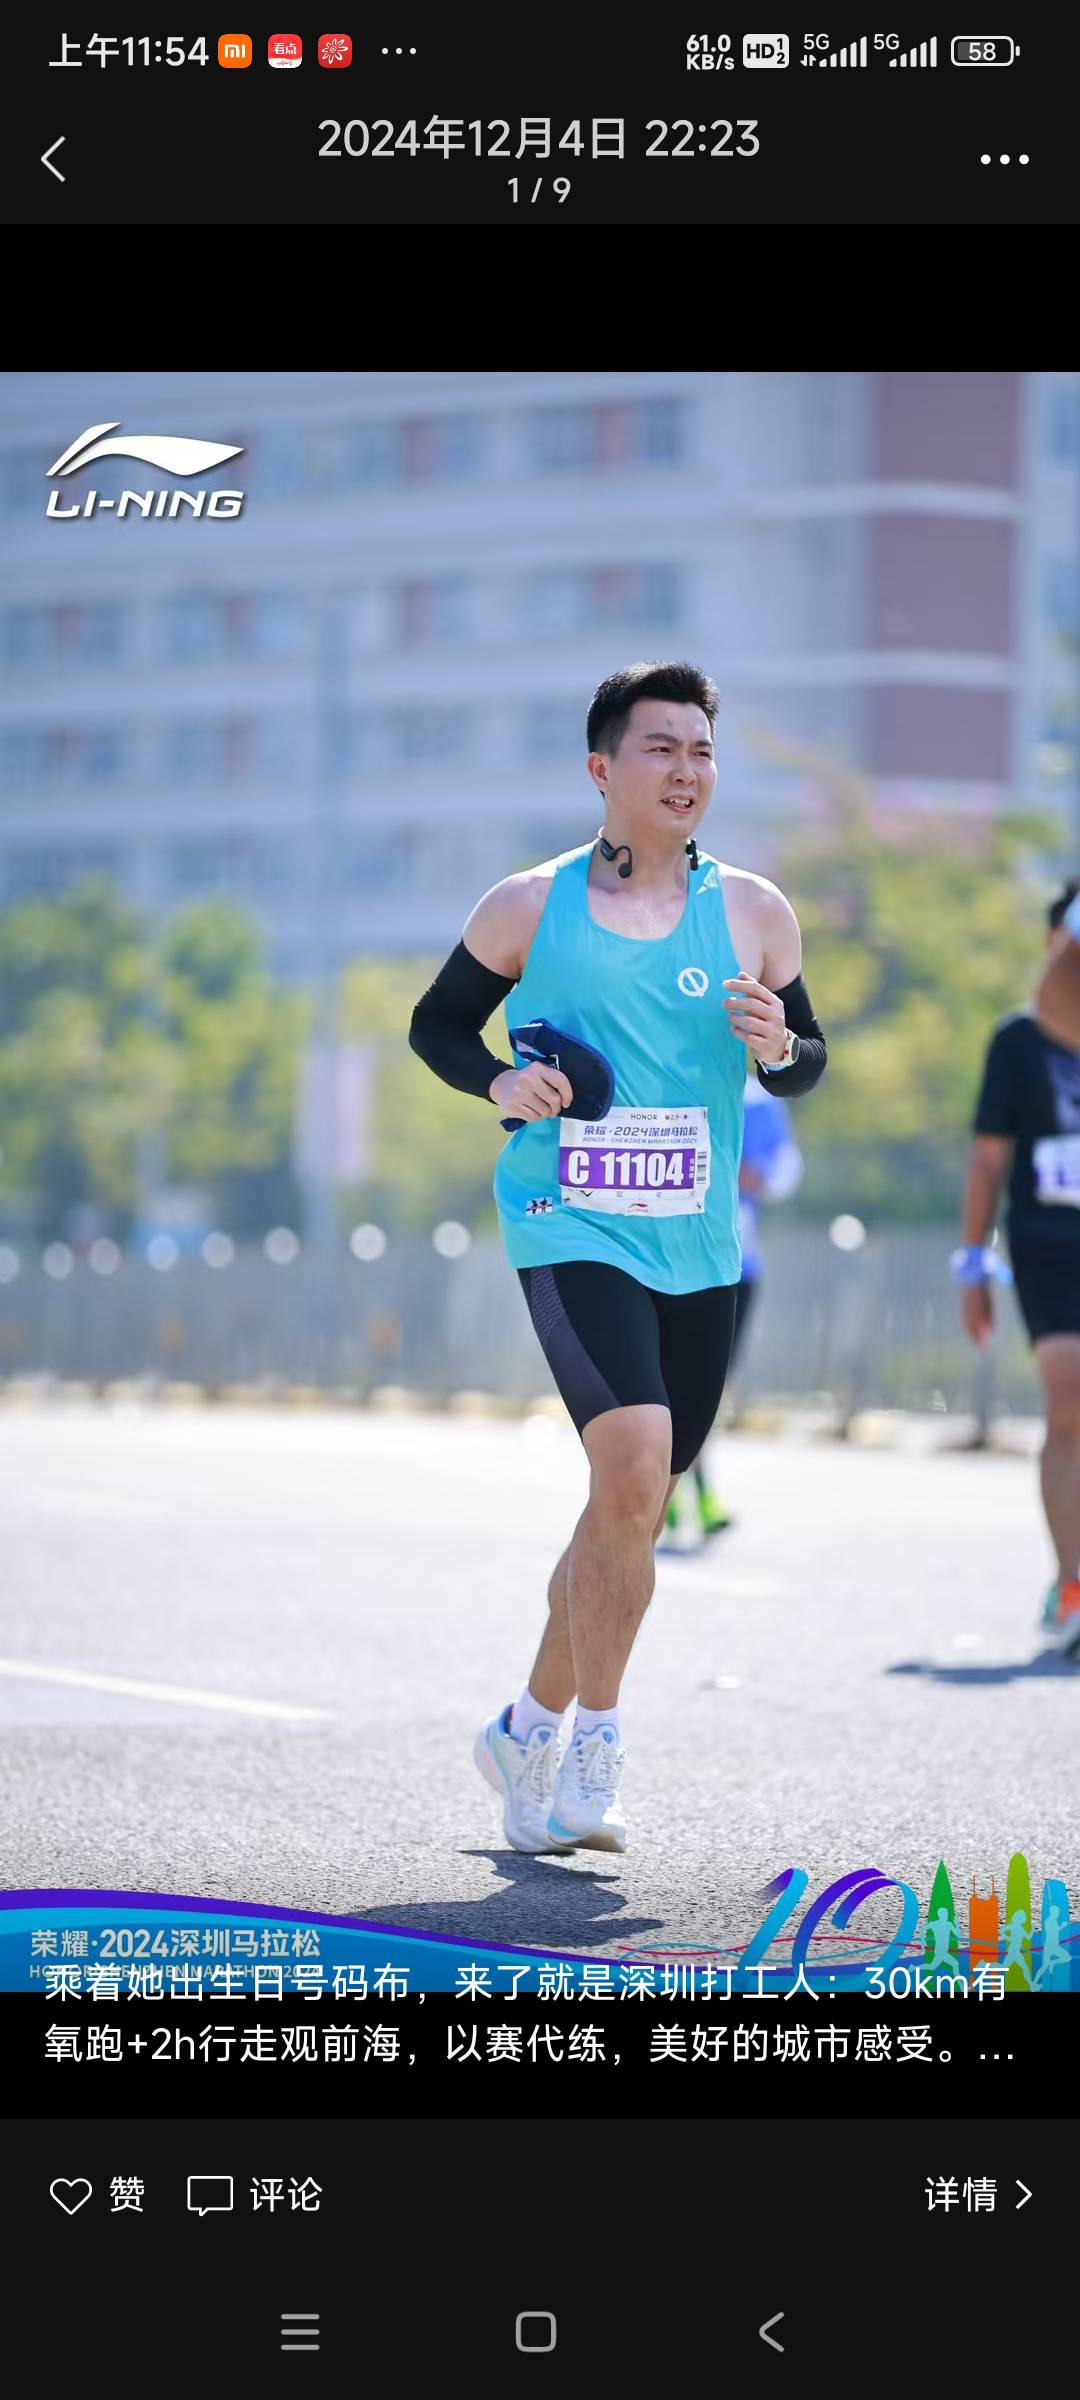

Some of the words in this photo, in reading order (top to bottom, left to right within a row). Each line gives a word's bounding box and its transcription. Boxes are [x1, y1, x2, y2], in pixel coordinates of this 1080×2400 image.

[49, 33, 210, 69] 上午11:54
[686, 35, 731, 52] 61.0
[746, 43, 775, 58] HD
[803, 34, 830, 50] 5G
[873, 34, 900, 50] 5G
[968, 43, 997, 61] 58
[686, 54, 735, 70] KB/s
[319, 114, 625, 160] 2024年12月4日
[646, 117, 760, 157] 22:23
[631, 1113, 658, 1121] HONOR
[568, 1150, 590, 1185] C
[600, 1151, 684, 1187] 11104
[110, 2176, 145, 2212] 赞
[249, 2176, 323, 2212] 评论
[924, 2176, 998, 2212] 详情
